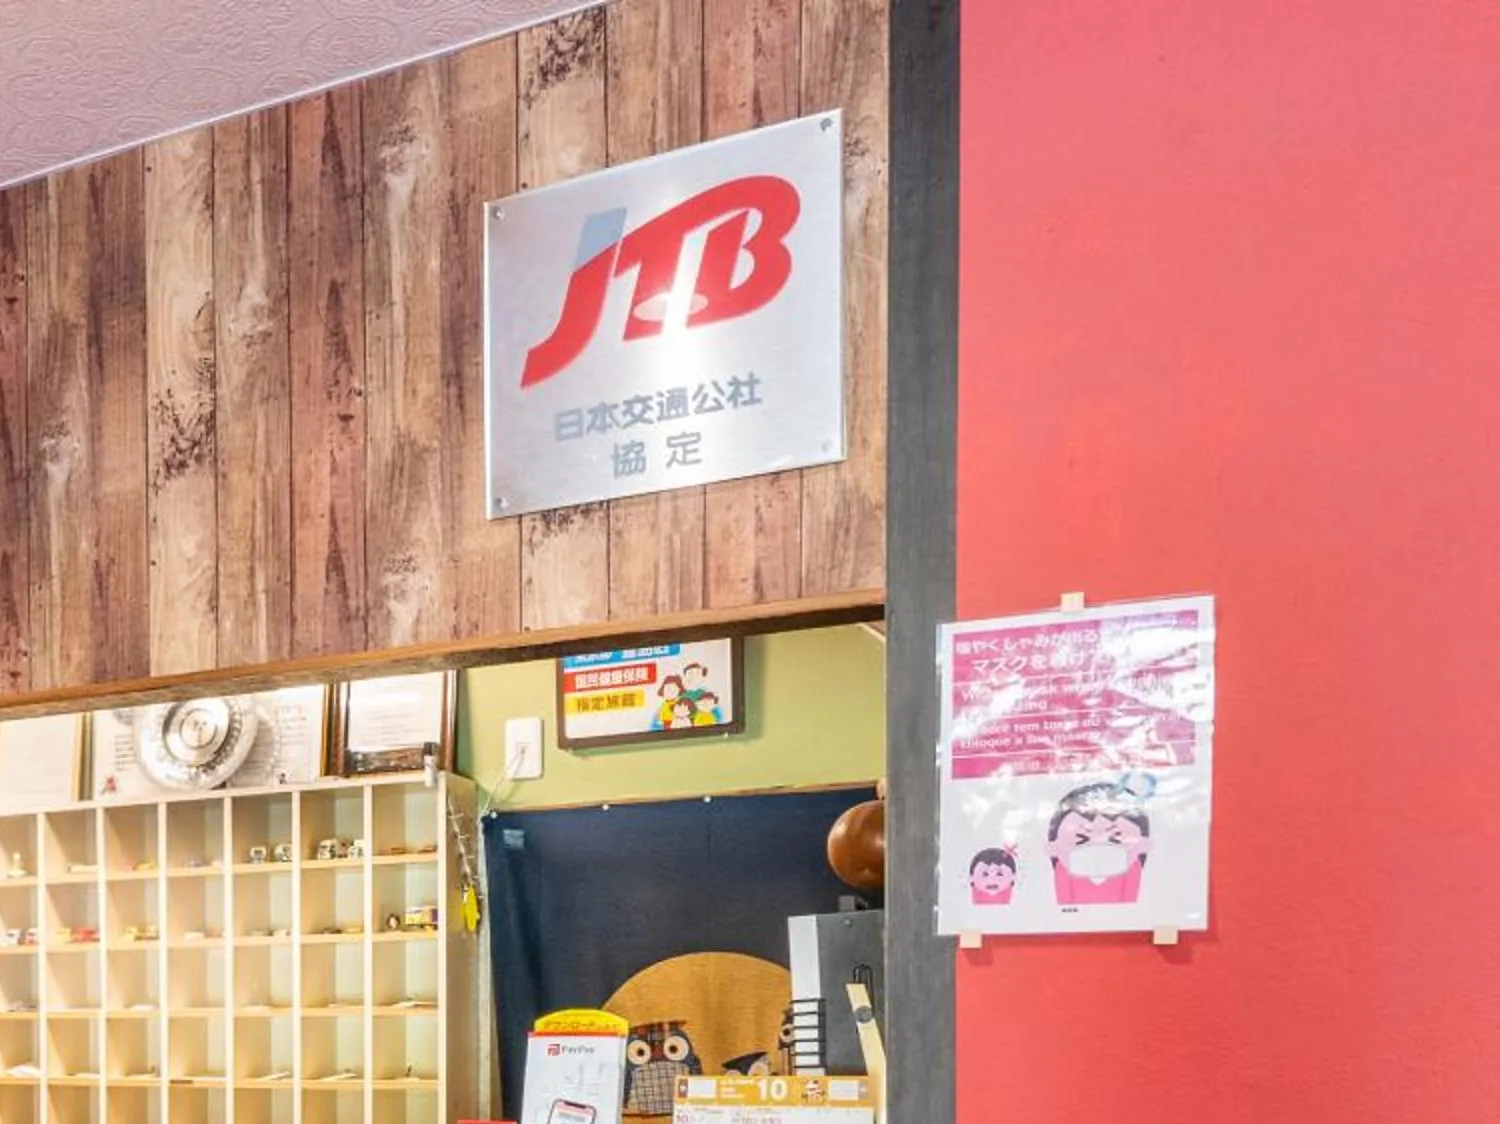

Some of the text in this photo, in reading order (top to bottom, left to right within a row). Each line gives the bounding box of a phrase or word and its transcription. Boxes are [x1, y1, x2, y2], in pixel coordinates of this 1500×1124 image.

[520, 175, 801, 389] JTB
[554, 372, 762, 442] 日本交通公社
[757, 1079, 789, 1101] 10
